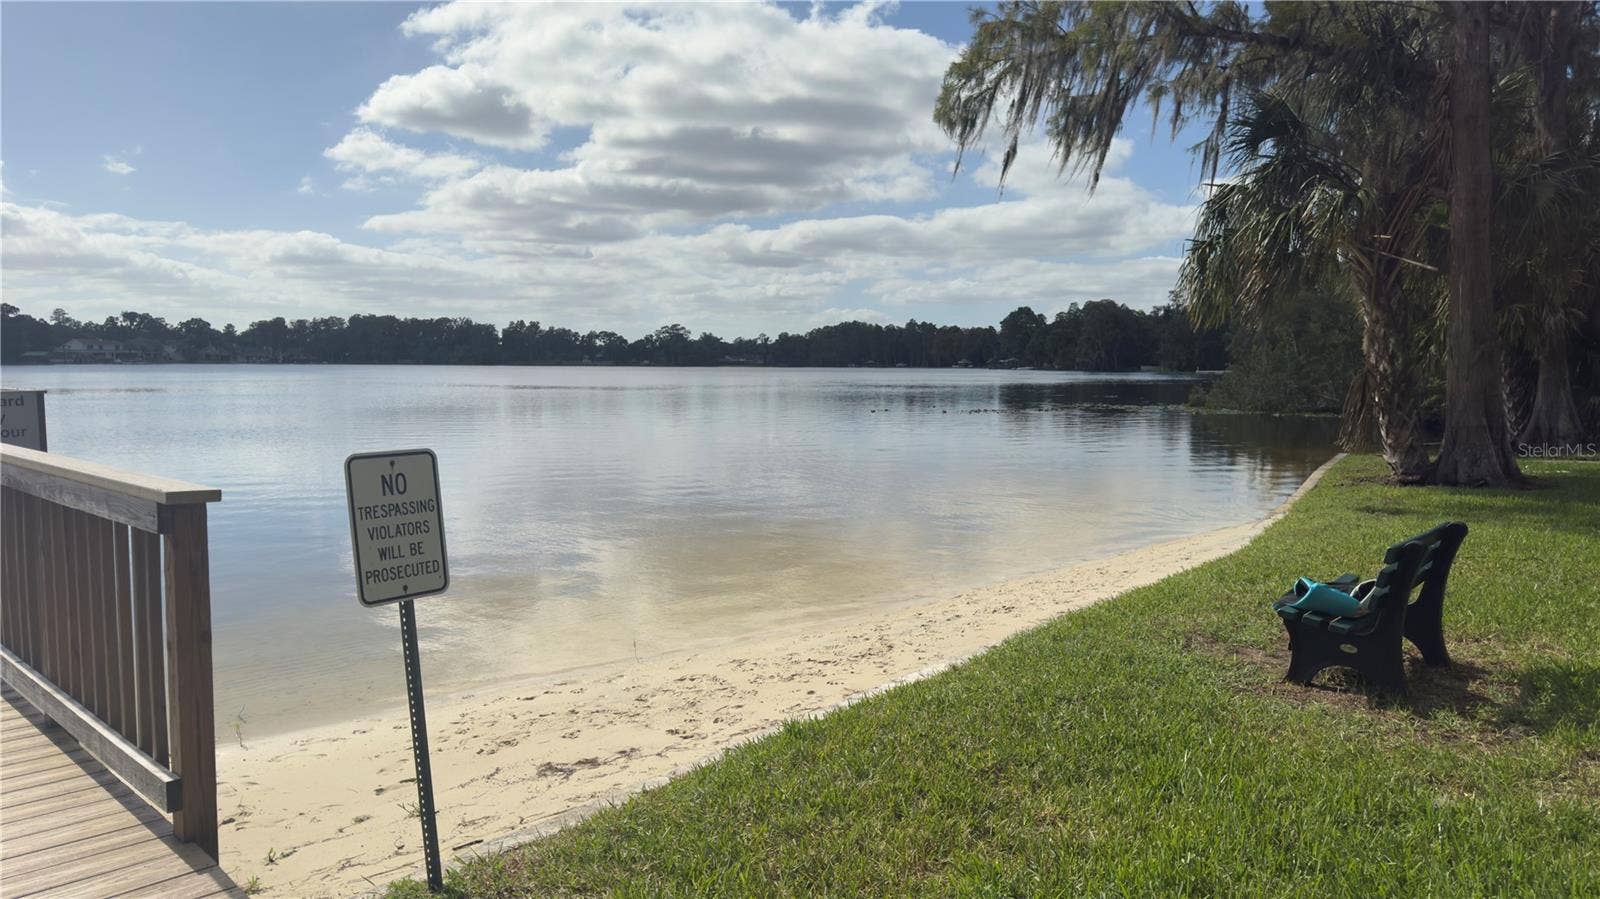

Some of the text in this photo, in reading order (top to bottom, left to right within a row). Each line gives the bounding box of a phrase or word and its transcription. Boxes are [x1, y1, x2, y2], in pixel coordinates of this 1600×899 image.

[380, 472, 407, 497] NO
[358, 498, 435, 521] TRESPASSING
[367, 520, 430, 541] VIOLATORS
[377, 541, 425, 562] WILL BE
[365, 559, 440, 585] PROSECUTED
